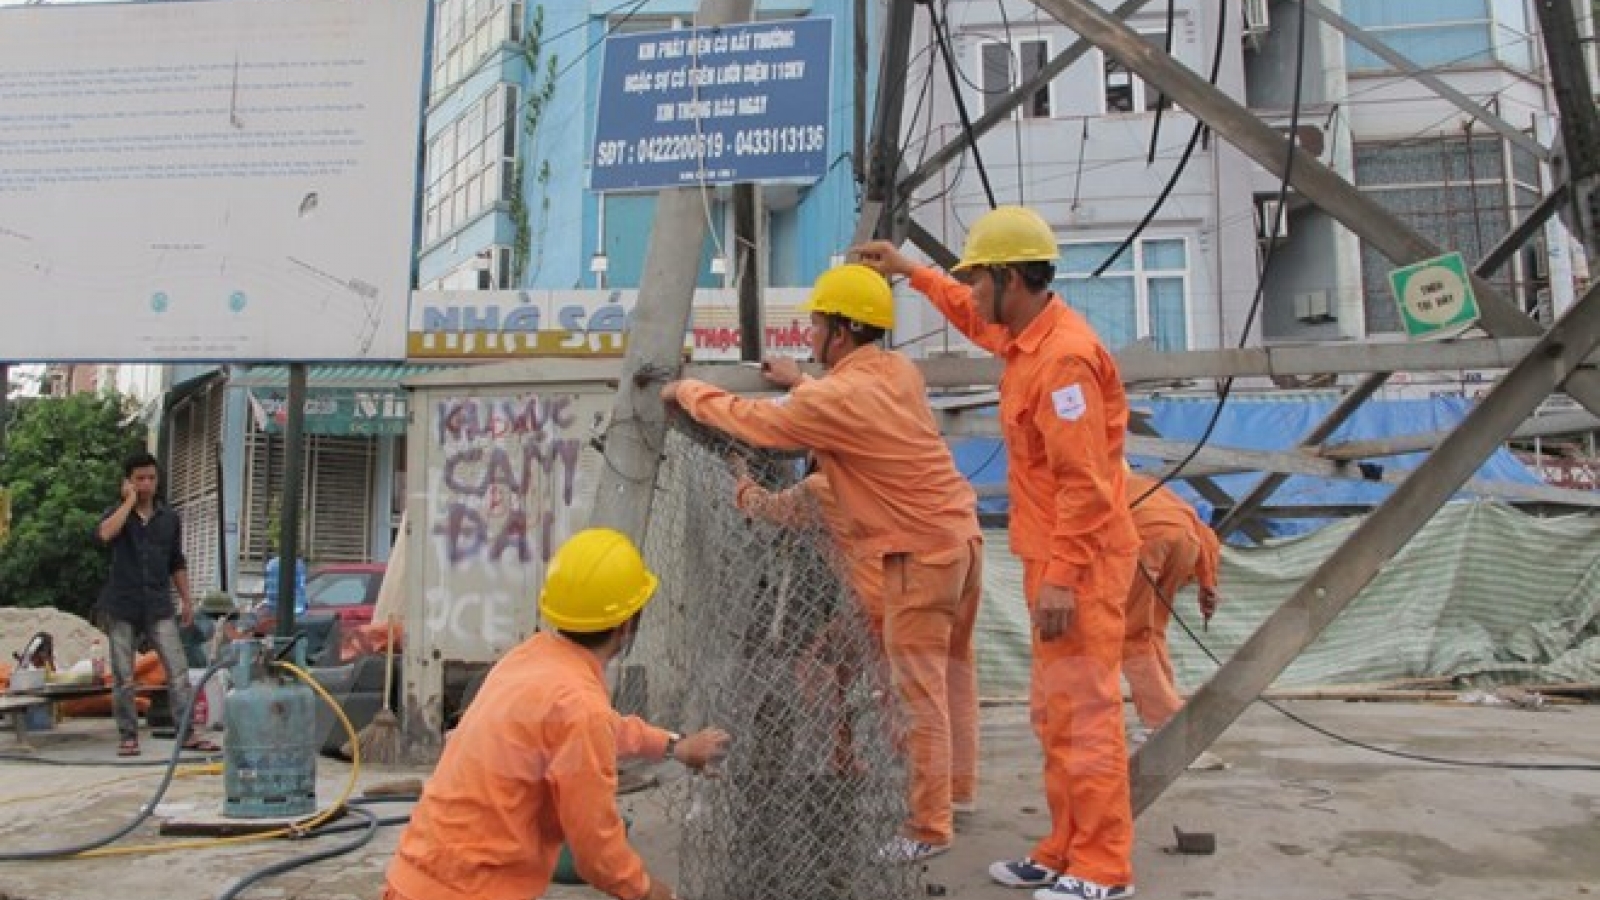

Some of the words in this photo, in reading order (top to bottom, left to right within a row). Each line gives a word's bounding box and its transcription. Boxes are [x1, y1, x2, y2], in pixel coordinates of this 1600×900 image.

[597, 139, 626, 167] SĐT
[423, 291, 540, 354] NHÀ
[558, 291, 632, 352] SÁ
